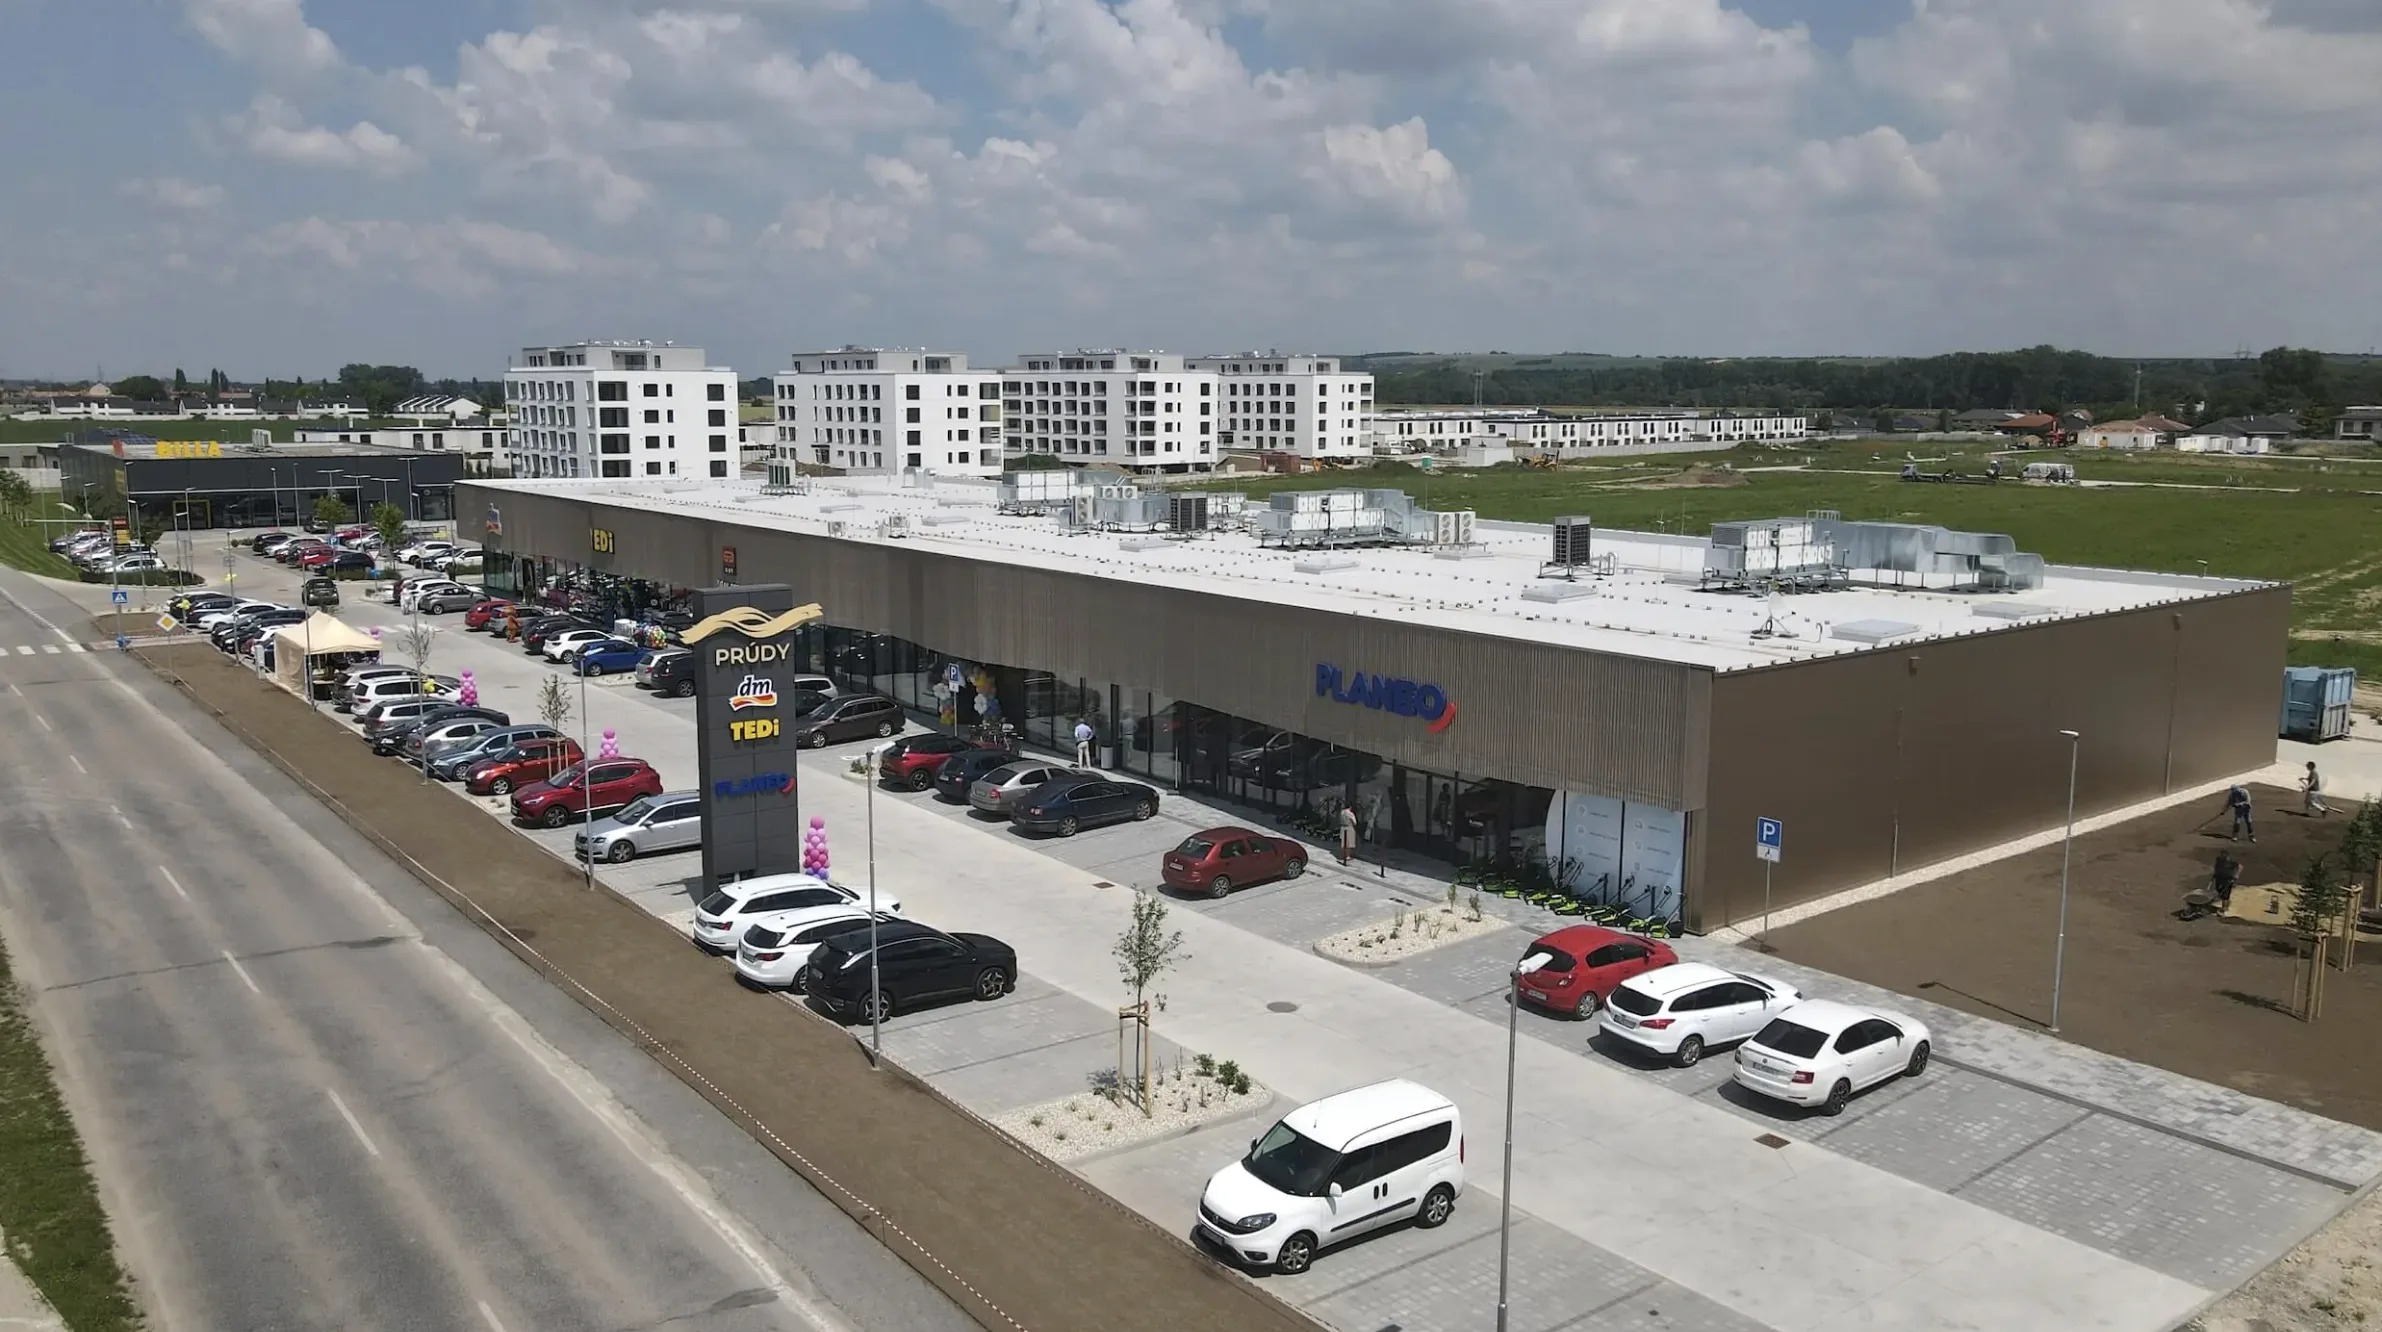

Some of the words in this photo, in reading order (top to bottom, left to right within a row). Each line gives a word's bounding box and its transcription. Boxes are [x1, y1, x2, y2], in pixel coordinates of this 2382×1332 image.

[590, 528, 614, 554] EDi
[715, 642, 790, 666] PRÚDY
[950, 666, 957, 680] P
[739, 675, 771, 696] dm
[1316, 662, 1448, 721] PLANEO
[730, 718, 780, 742] TEDi
[1763, 821, 1776, 841] P
